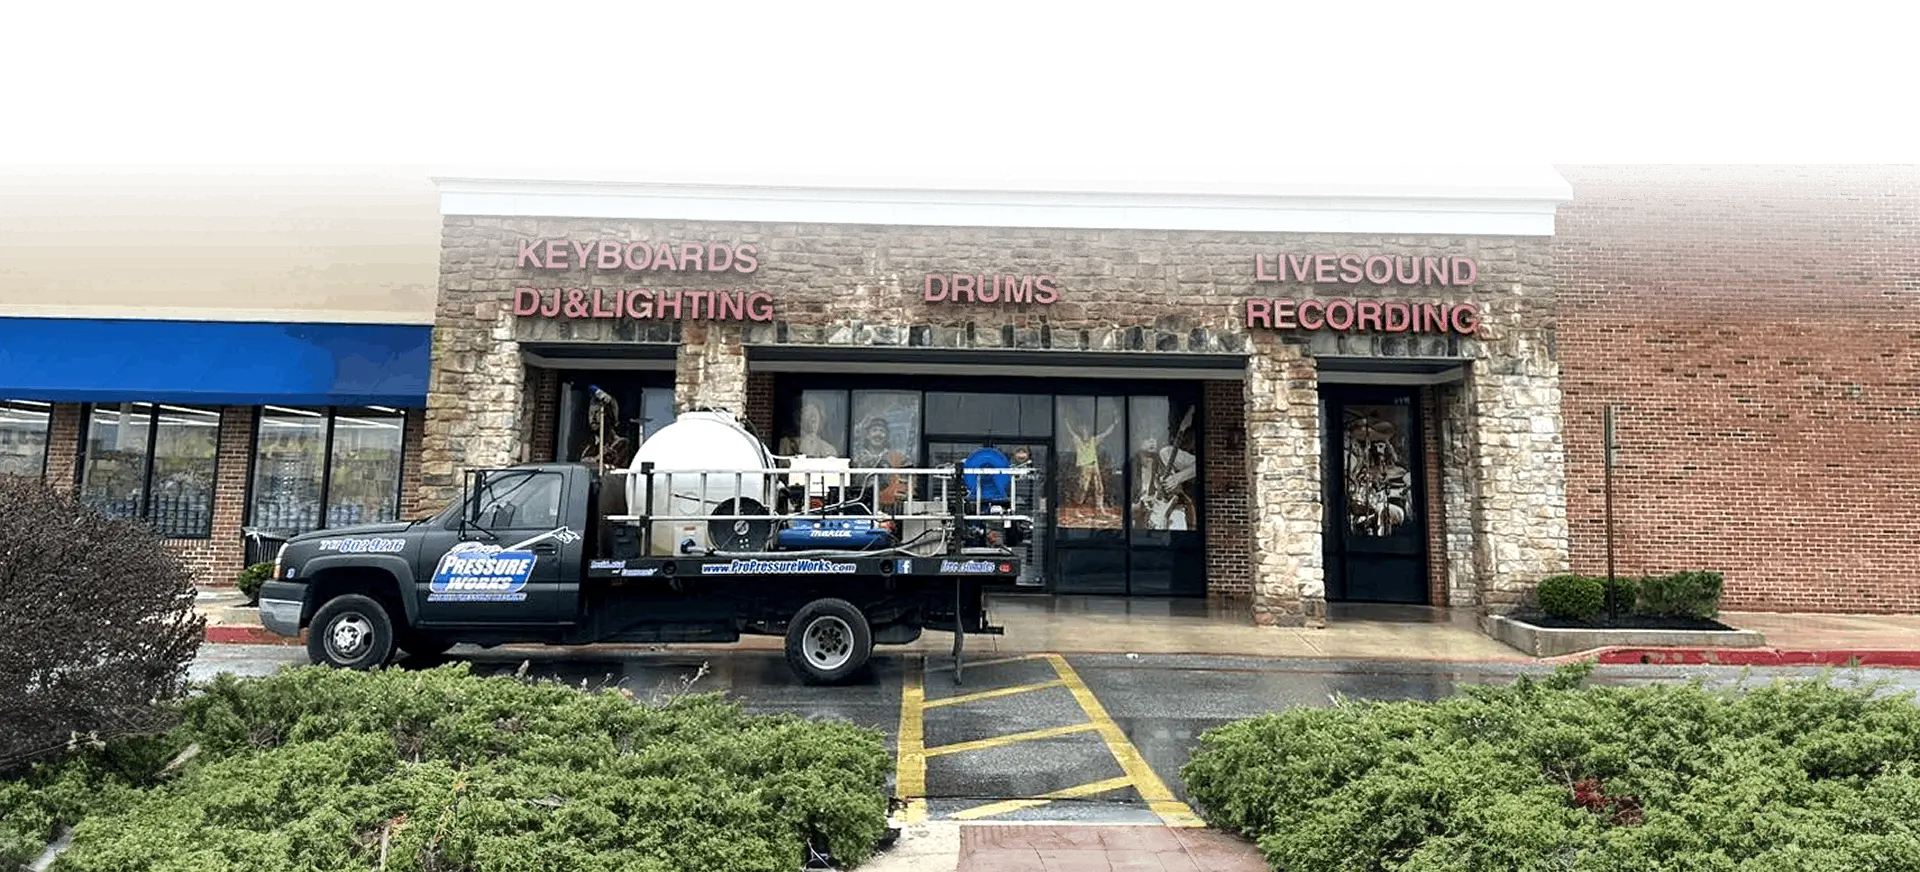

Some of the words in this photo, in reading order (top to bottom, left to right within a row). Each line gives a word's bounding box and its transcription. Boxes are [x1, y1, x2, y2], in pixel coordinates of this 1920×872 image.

[516, 239, 759, 274] KEYBOARDS
[1254, 252, 1478, 287] LIVESOUND
[513, 286, 775, 323] DJ&LIGHTING
[923, 272, 1059, 306] DRUMS
[1246, 298, 1479, 335] RECORDING
[440, 555, 531, 576] PRESSURE
[701, 559, 856, 574] www.ProPressureWorks.com
[446, 576, 514, 591] WORKS
